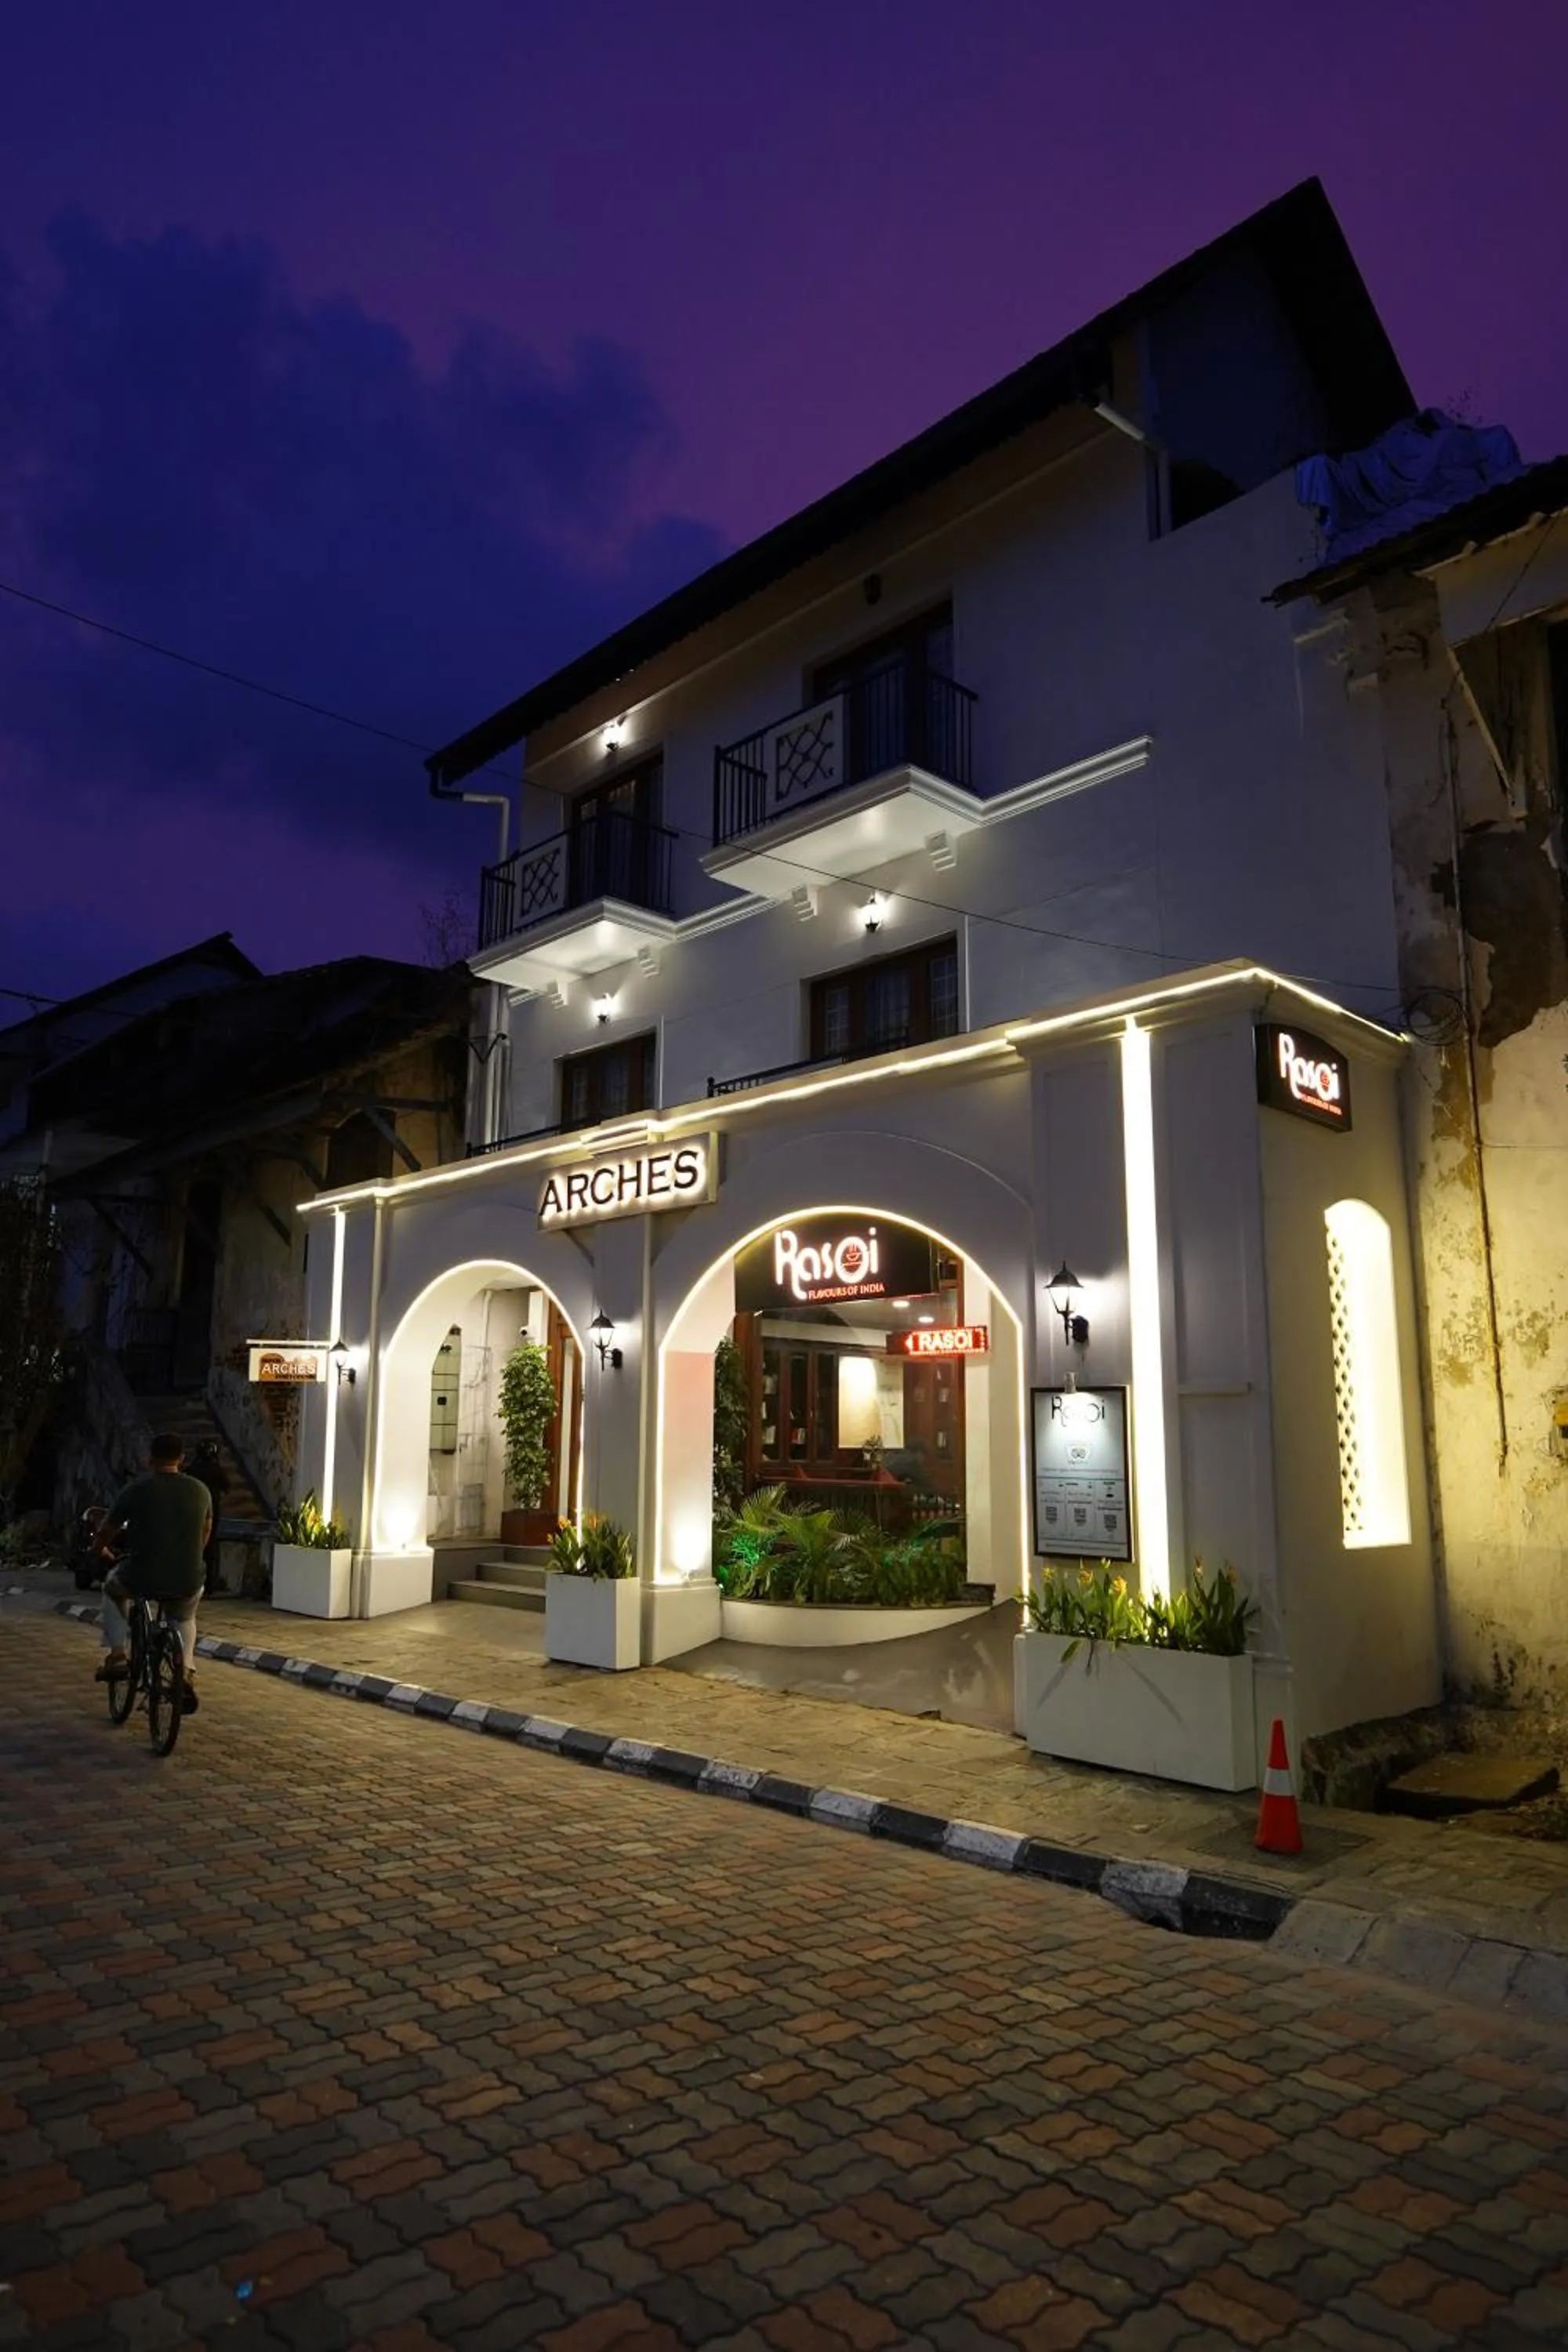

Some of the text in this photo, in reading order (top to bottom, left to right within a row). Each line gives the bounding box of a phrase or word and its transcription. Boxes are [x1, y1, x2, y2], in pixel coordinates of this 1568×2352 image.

[539, 1149, 699, 1216] ARCHES
[775, 1226, 879, 1301] Rasoi
[808, 1282, 885, 1301] FLAVOURS OF INDIA
[918, 1330, 973, 1352] RASOI
[261, 1363, 316, 1375] ARCHES
[1051, 1395, 1105, 1428] Roi
